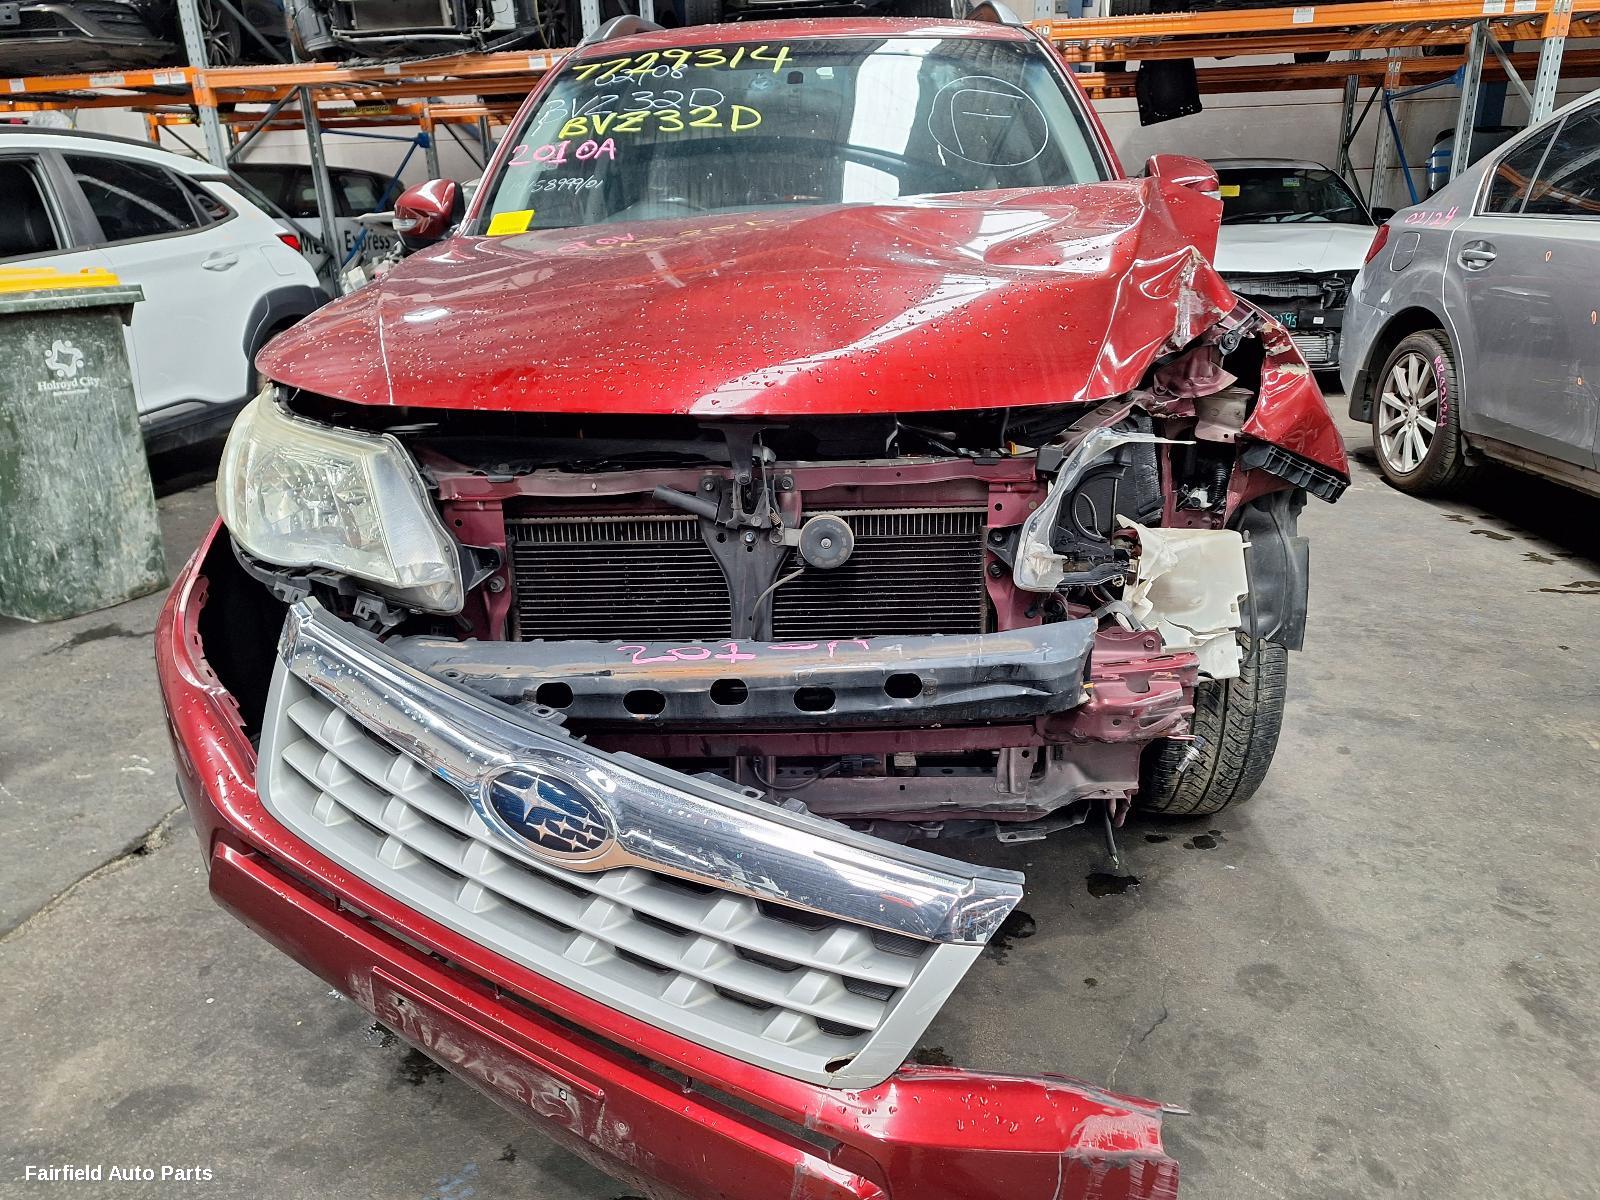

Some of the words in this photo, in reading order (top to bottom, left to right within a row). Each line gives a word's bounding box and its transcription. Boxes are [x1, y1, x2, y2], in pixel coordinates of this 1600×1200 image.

[572, 46, 793, 81] 7729314
[558, 104, 762, 139] BVZ32D
[508, 137, 617, 166] 2010A
[37, 377, 79, 392] Holroyd
[79, 375, 100, 387] City
